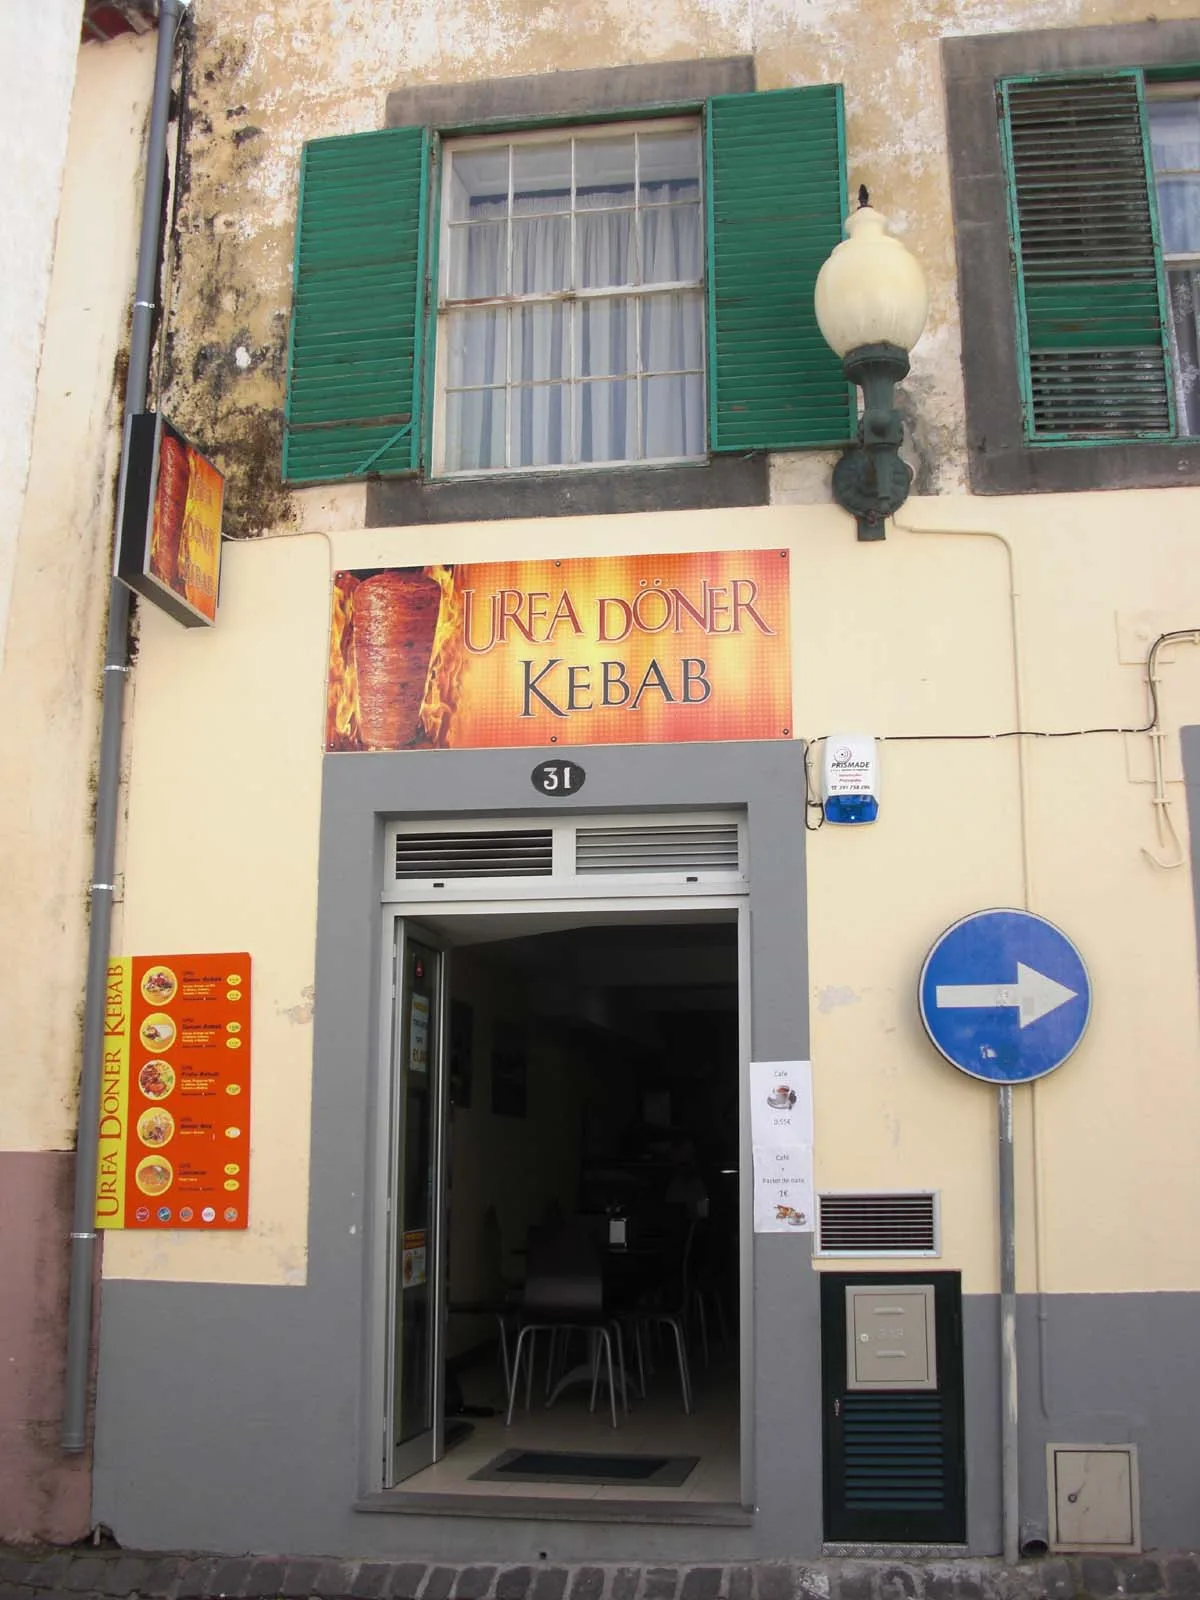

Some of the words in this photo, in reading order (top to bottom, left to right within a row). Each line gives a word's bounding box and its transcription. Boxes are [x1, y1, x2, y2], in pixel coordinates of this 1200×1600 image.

[462, 588, 584, 654] URFA
[595, 579, 776, 643] DÖNER
[520, 656, 712, 718] KEBAB
[543, 766, 571, 790] 31
[104, 964, 125, 1037] KEBAB
[97, 1152, 120, 1217] URFA
